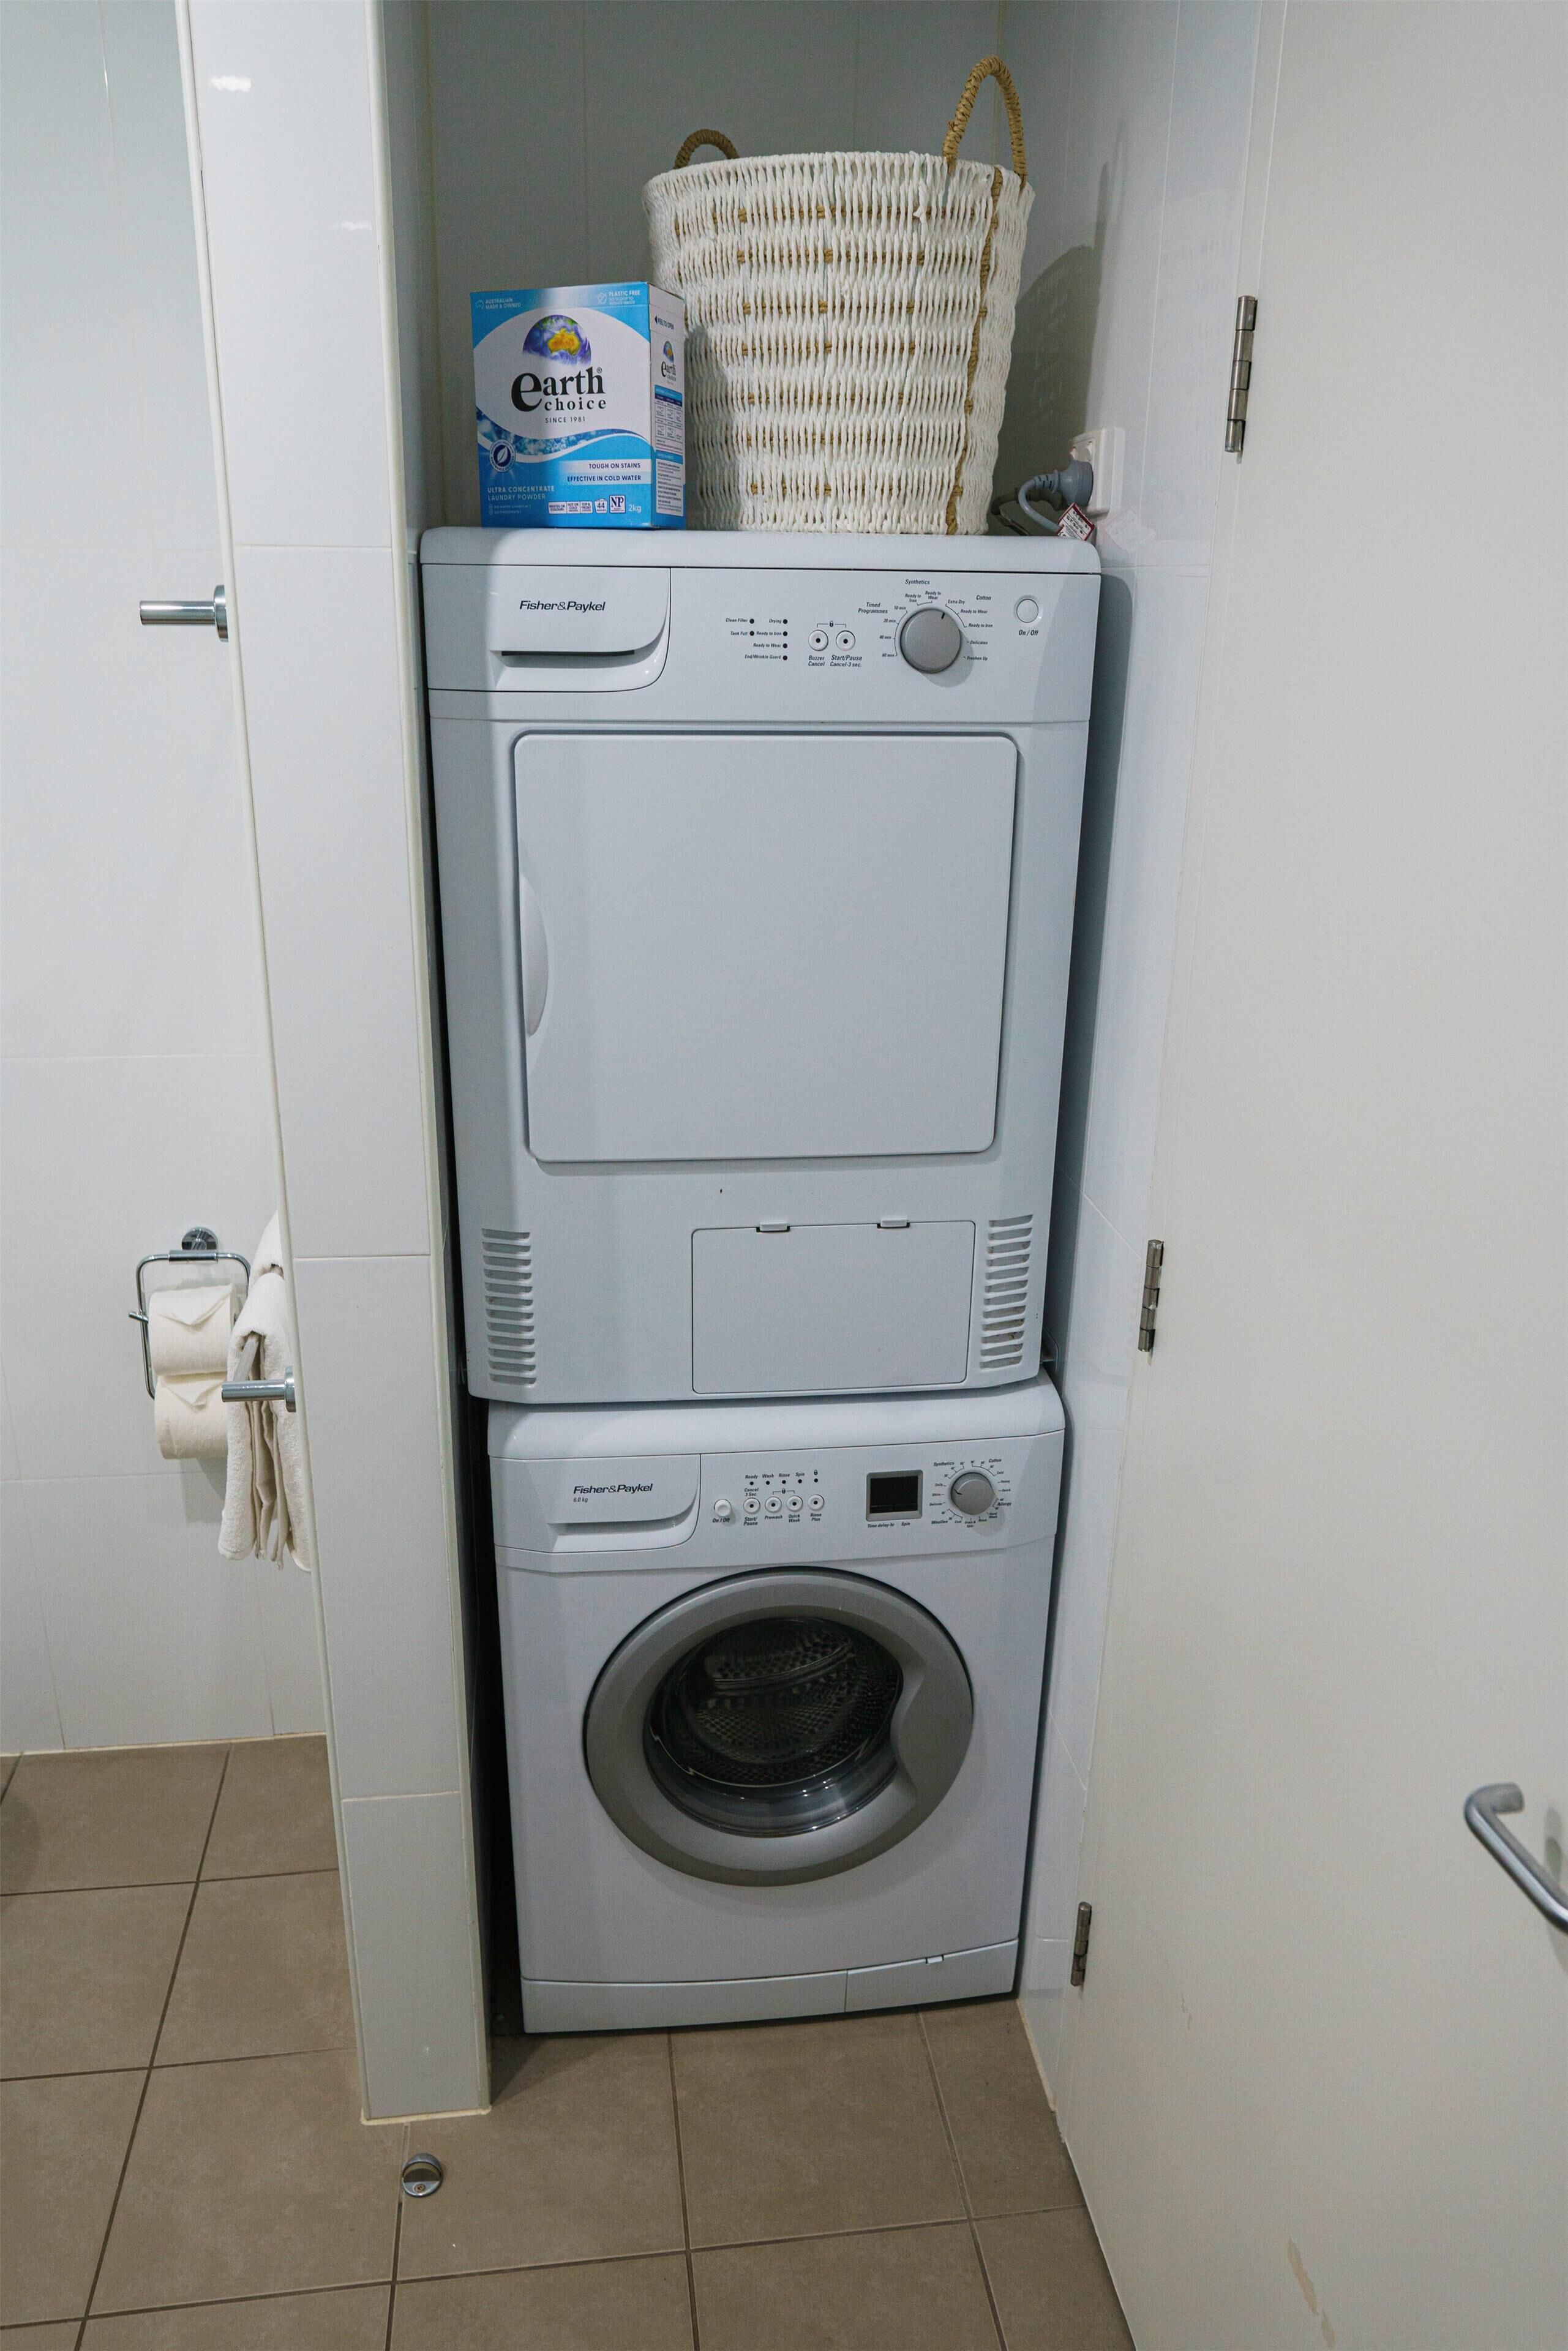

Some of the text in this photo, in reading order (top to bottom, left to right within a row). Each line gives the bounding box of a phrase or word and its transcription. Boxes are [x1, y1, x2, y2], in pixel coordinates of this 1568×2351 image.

[661, 361, 676, 377] earth
[511, 366, 606, 412] earth
[544, 397, 606, 411] choice
[611, 497, 624, 508] NP
[628, 504, 642, 513] 2kg
[519, 600, 606, 613] Fisher&Paykel
[573, 1483, 653, 1494] Fisher&Paykel
